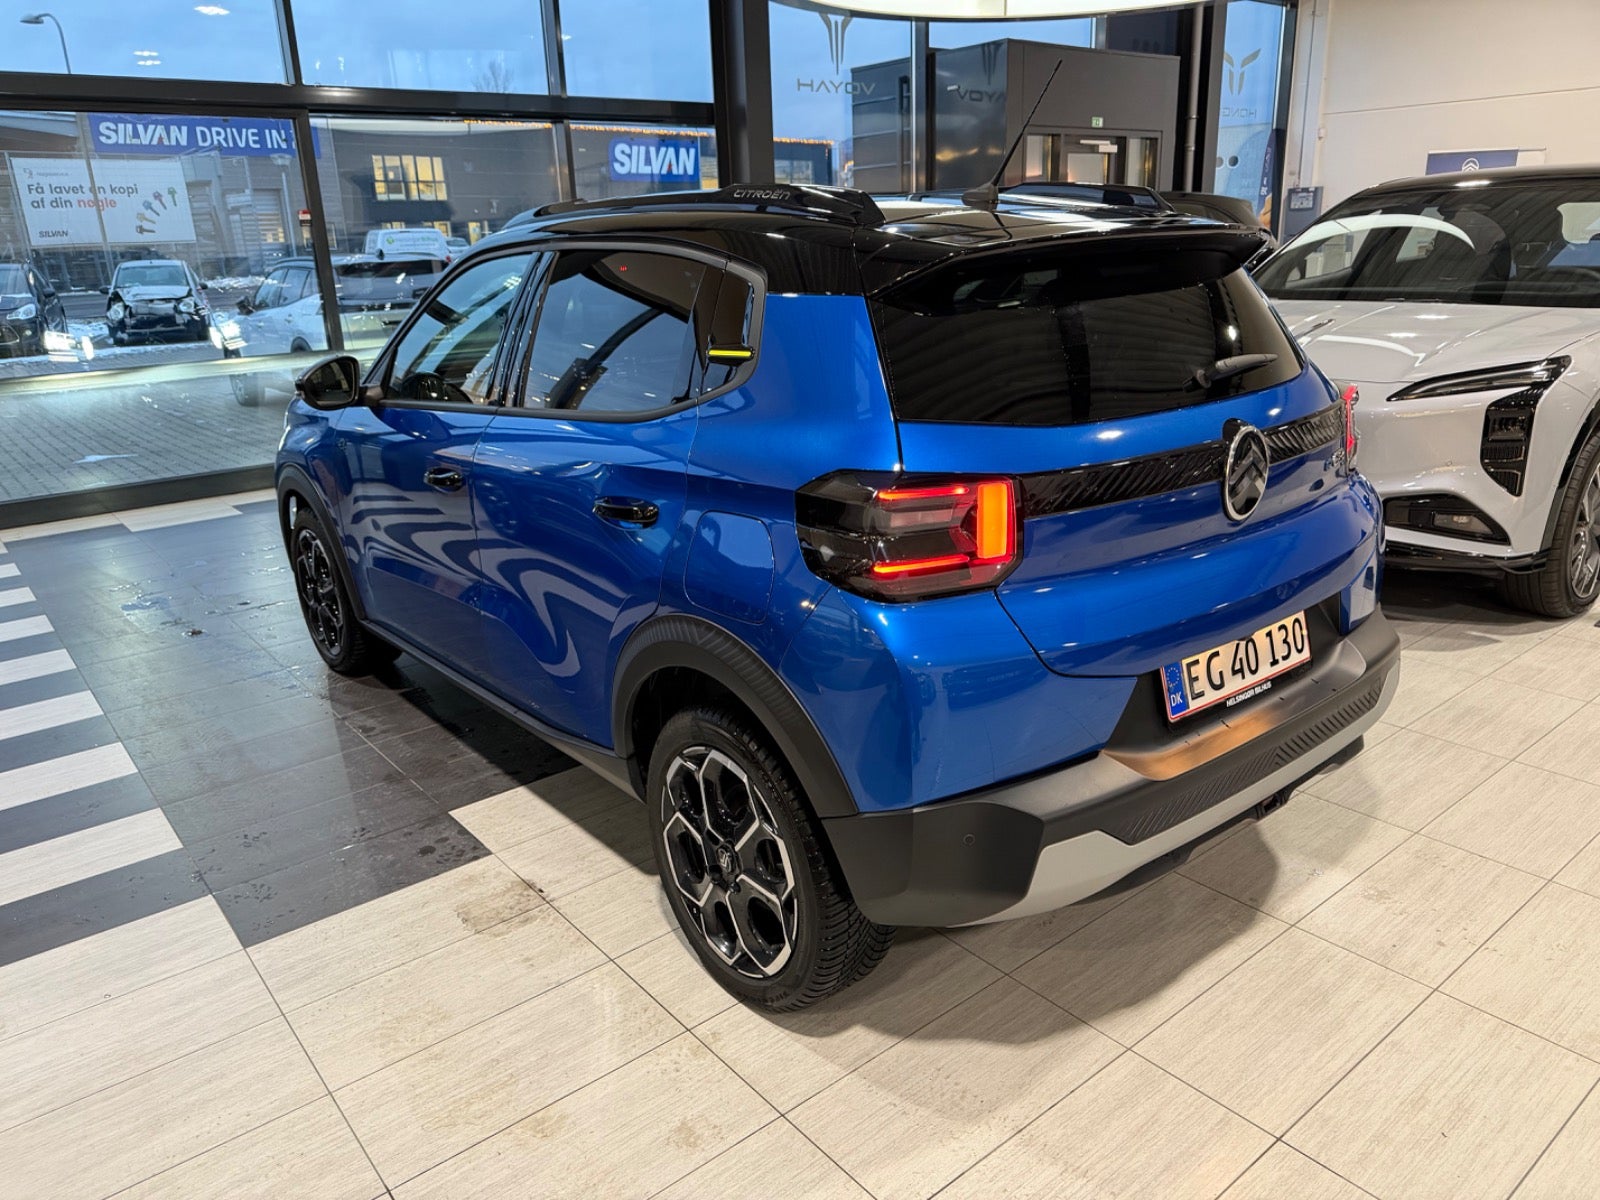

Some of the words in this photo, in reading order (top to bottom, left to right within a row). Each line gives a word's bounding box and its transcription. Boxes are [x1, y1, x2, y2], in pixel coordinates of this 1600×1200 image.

[98, 121, 188, 146] SILVAN
[196, 126, 261, 149] DRIVE
[265, 129, 288, 149] IN
[613, 142, 696, 176] SILVAN
[27, 182, 45, 195] Få
[49, 183, 85, 195] lavet
[110, 183, 139, 197] kopi
[31, 196, 45, 209] af
[50, 197, 73, 208] din
[39, 230, 69, 239] SILVAN
[1187, 650, 1226, 700] EG
[1231, 637, 1260, 680] 40
[1265, 618, 1305, 668] 130
[1171, 693, 1183, 706] DK
